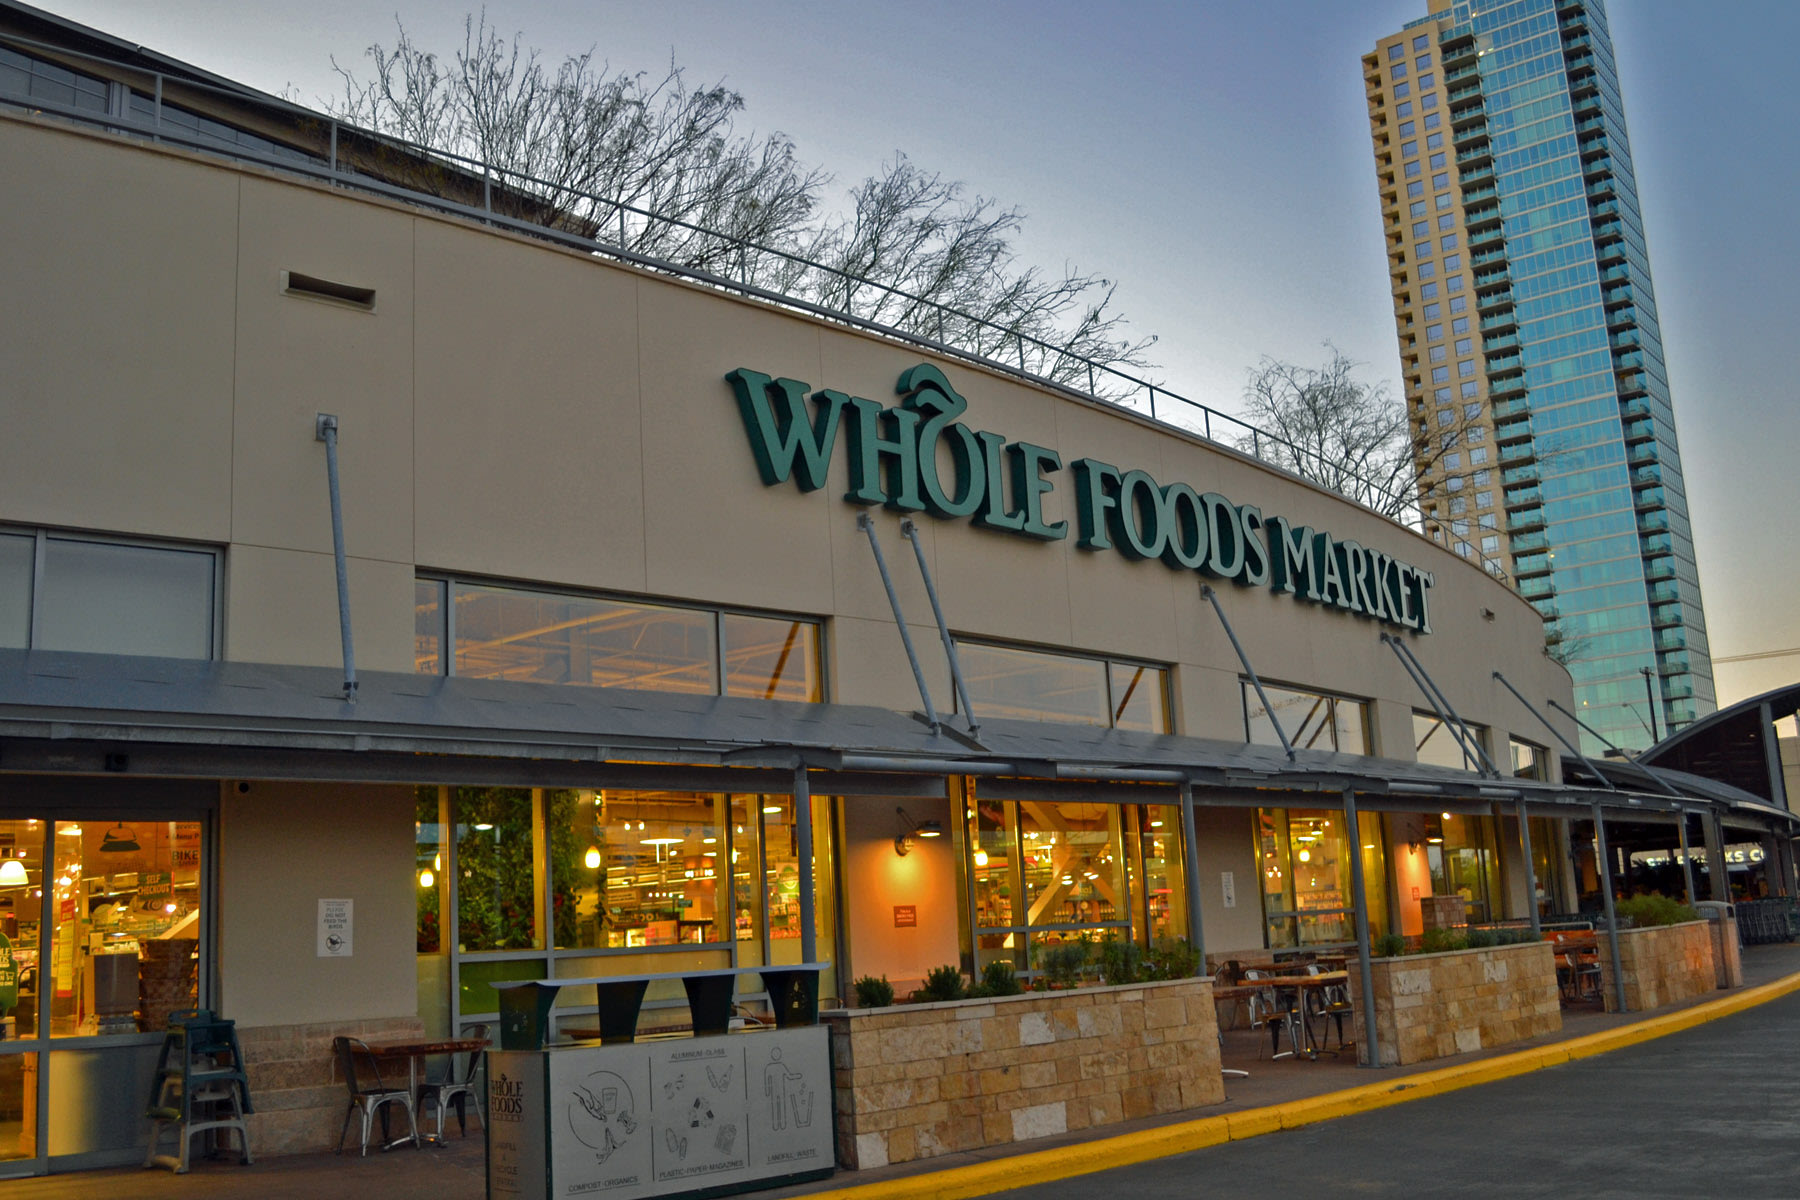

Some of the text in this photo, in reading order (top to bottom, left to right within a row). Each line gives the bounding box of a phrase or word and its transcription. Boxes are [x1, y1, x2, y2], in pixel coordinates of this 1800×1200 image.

[725, 363, 1435, 636] WHOLE FOODS MARKET
[171, 849, 199, 861] BIKE
[146, 874, 161, 884] SELF
[137, 882, 171, 896] CHECKOUT
